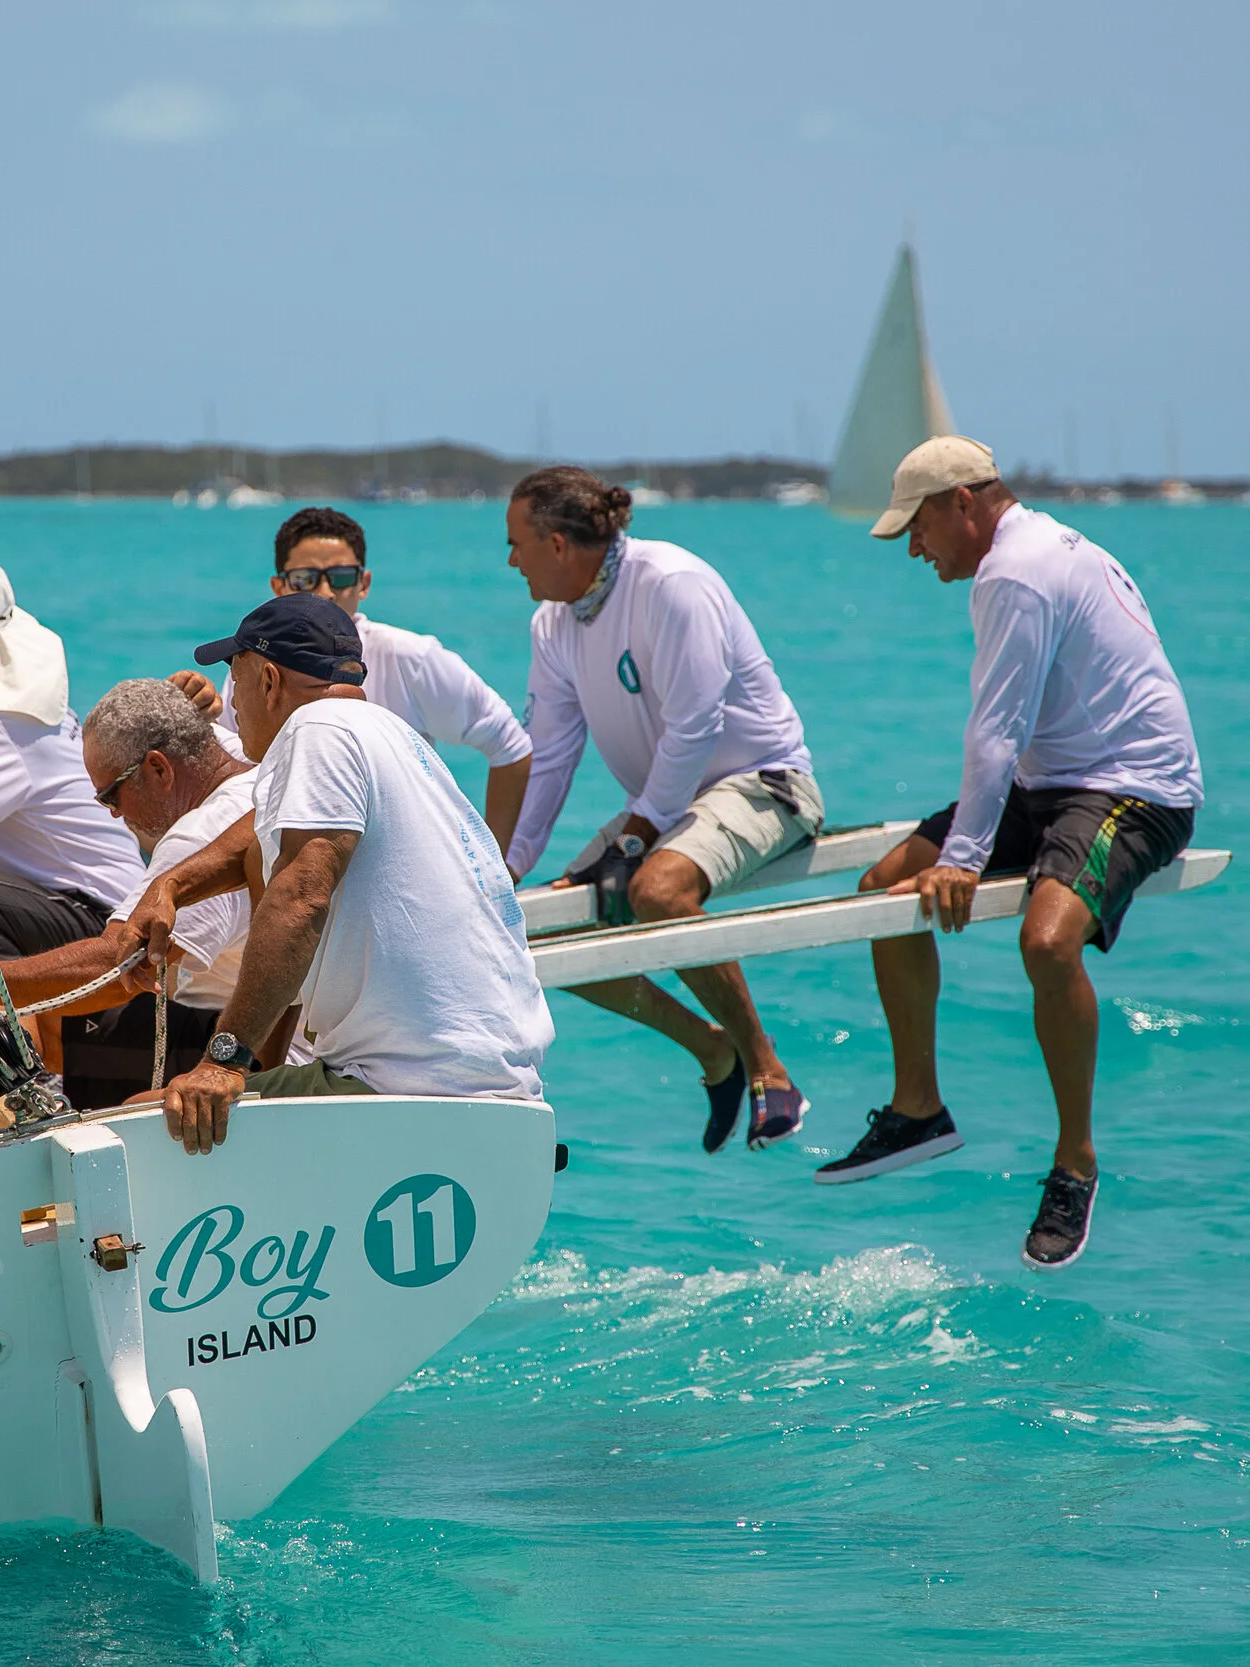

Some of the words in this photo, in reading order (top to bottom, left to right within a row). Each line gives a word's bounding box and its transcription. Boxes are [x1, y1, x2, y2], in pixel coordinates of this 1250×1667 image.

[255, 637, 270, 652] 18
[149, 1205, 336, 1320] Boy
[376, 1184, 457, 1275] 11
[188, 1314, 318, 1367] ISLAND
